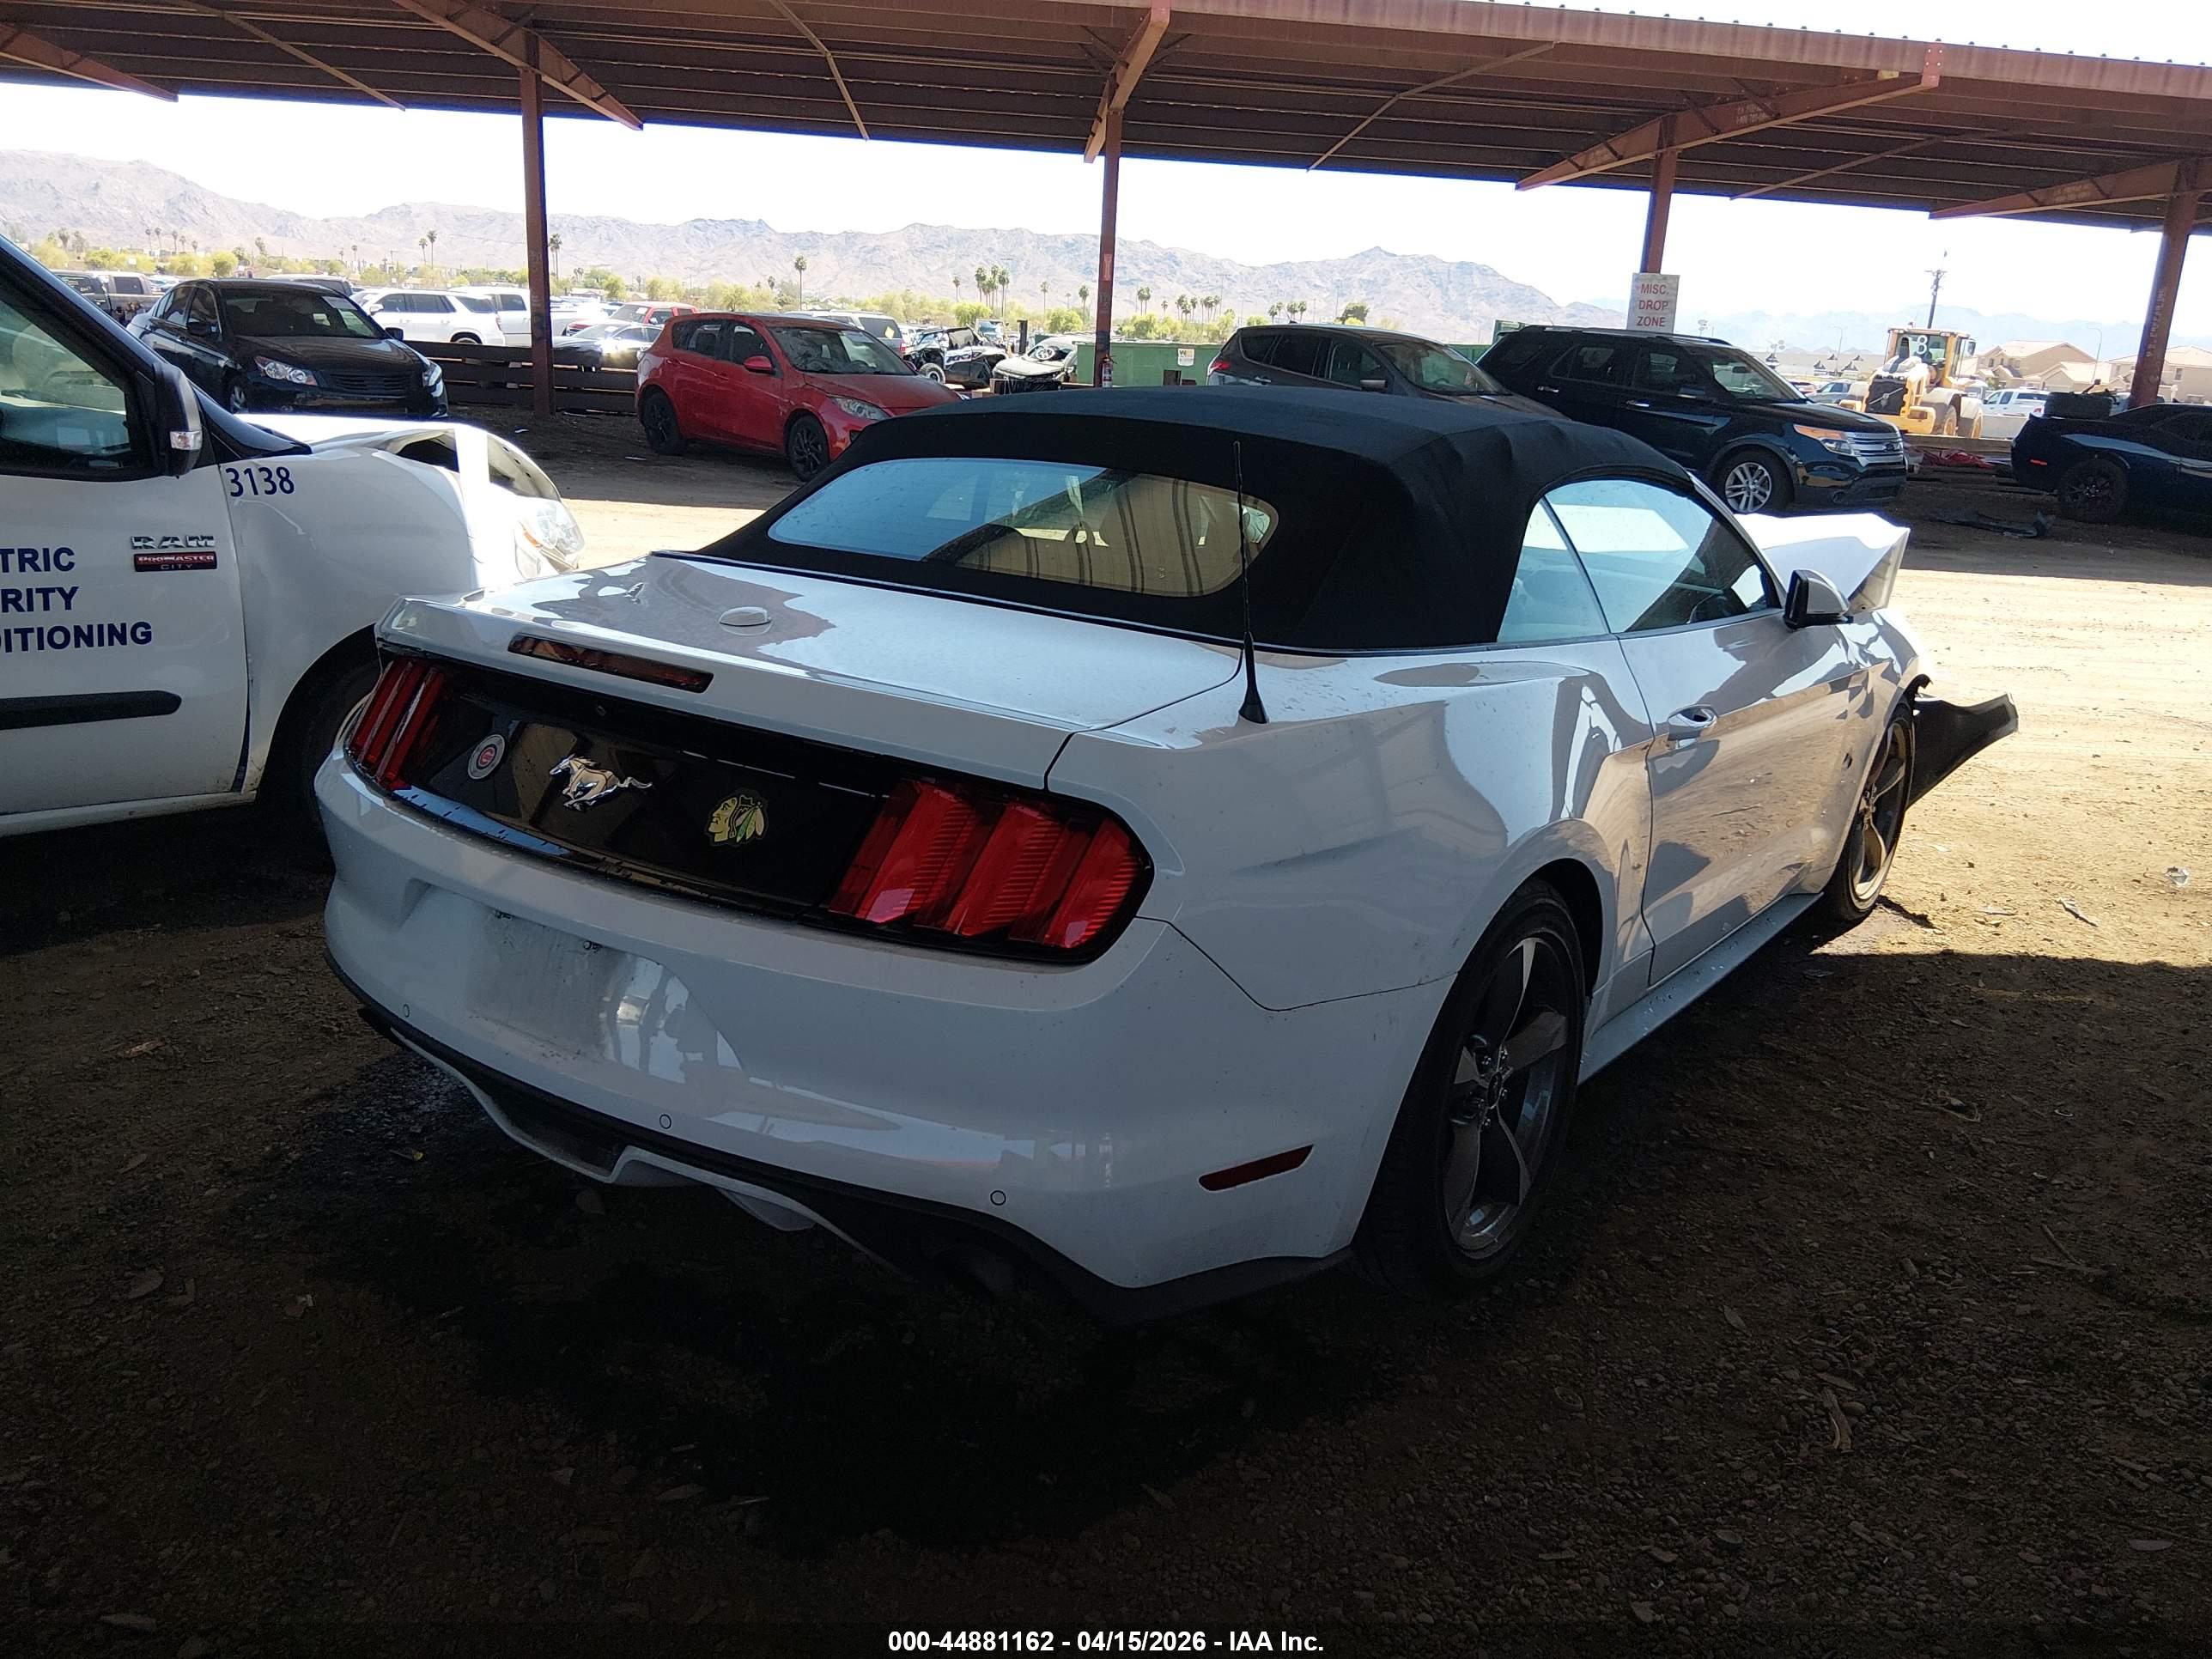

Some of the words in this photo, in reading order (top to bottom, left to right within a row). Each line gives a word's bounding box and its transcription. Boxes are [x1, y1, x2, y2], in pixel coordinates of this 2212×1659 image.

[1640, 283, 1669, 295] MISC.
[1638, 300, 1669, 310] DROP
[1637, 316, 1666, 327] ZONE
[1916, 335, 1928, 356] 8
[225, 466, 295, 497] 3138
[131, 535, 216, 550] RAM
[1, 586, 79, 613] RITY
[0, 622, 152, 653] ITIONING
